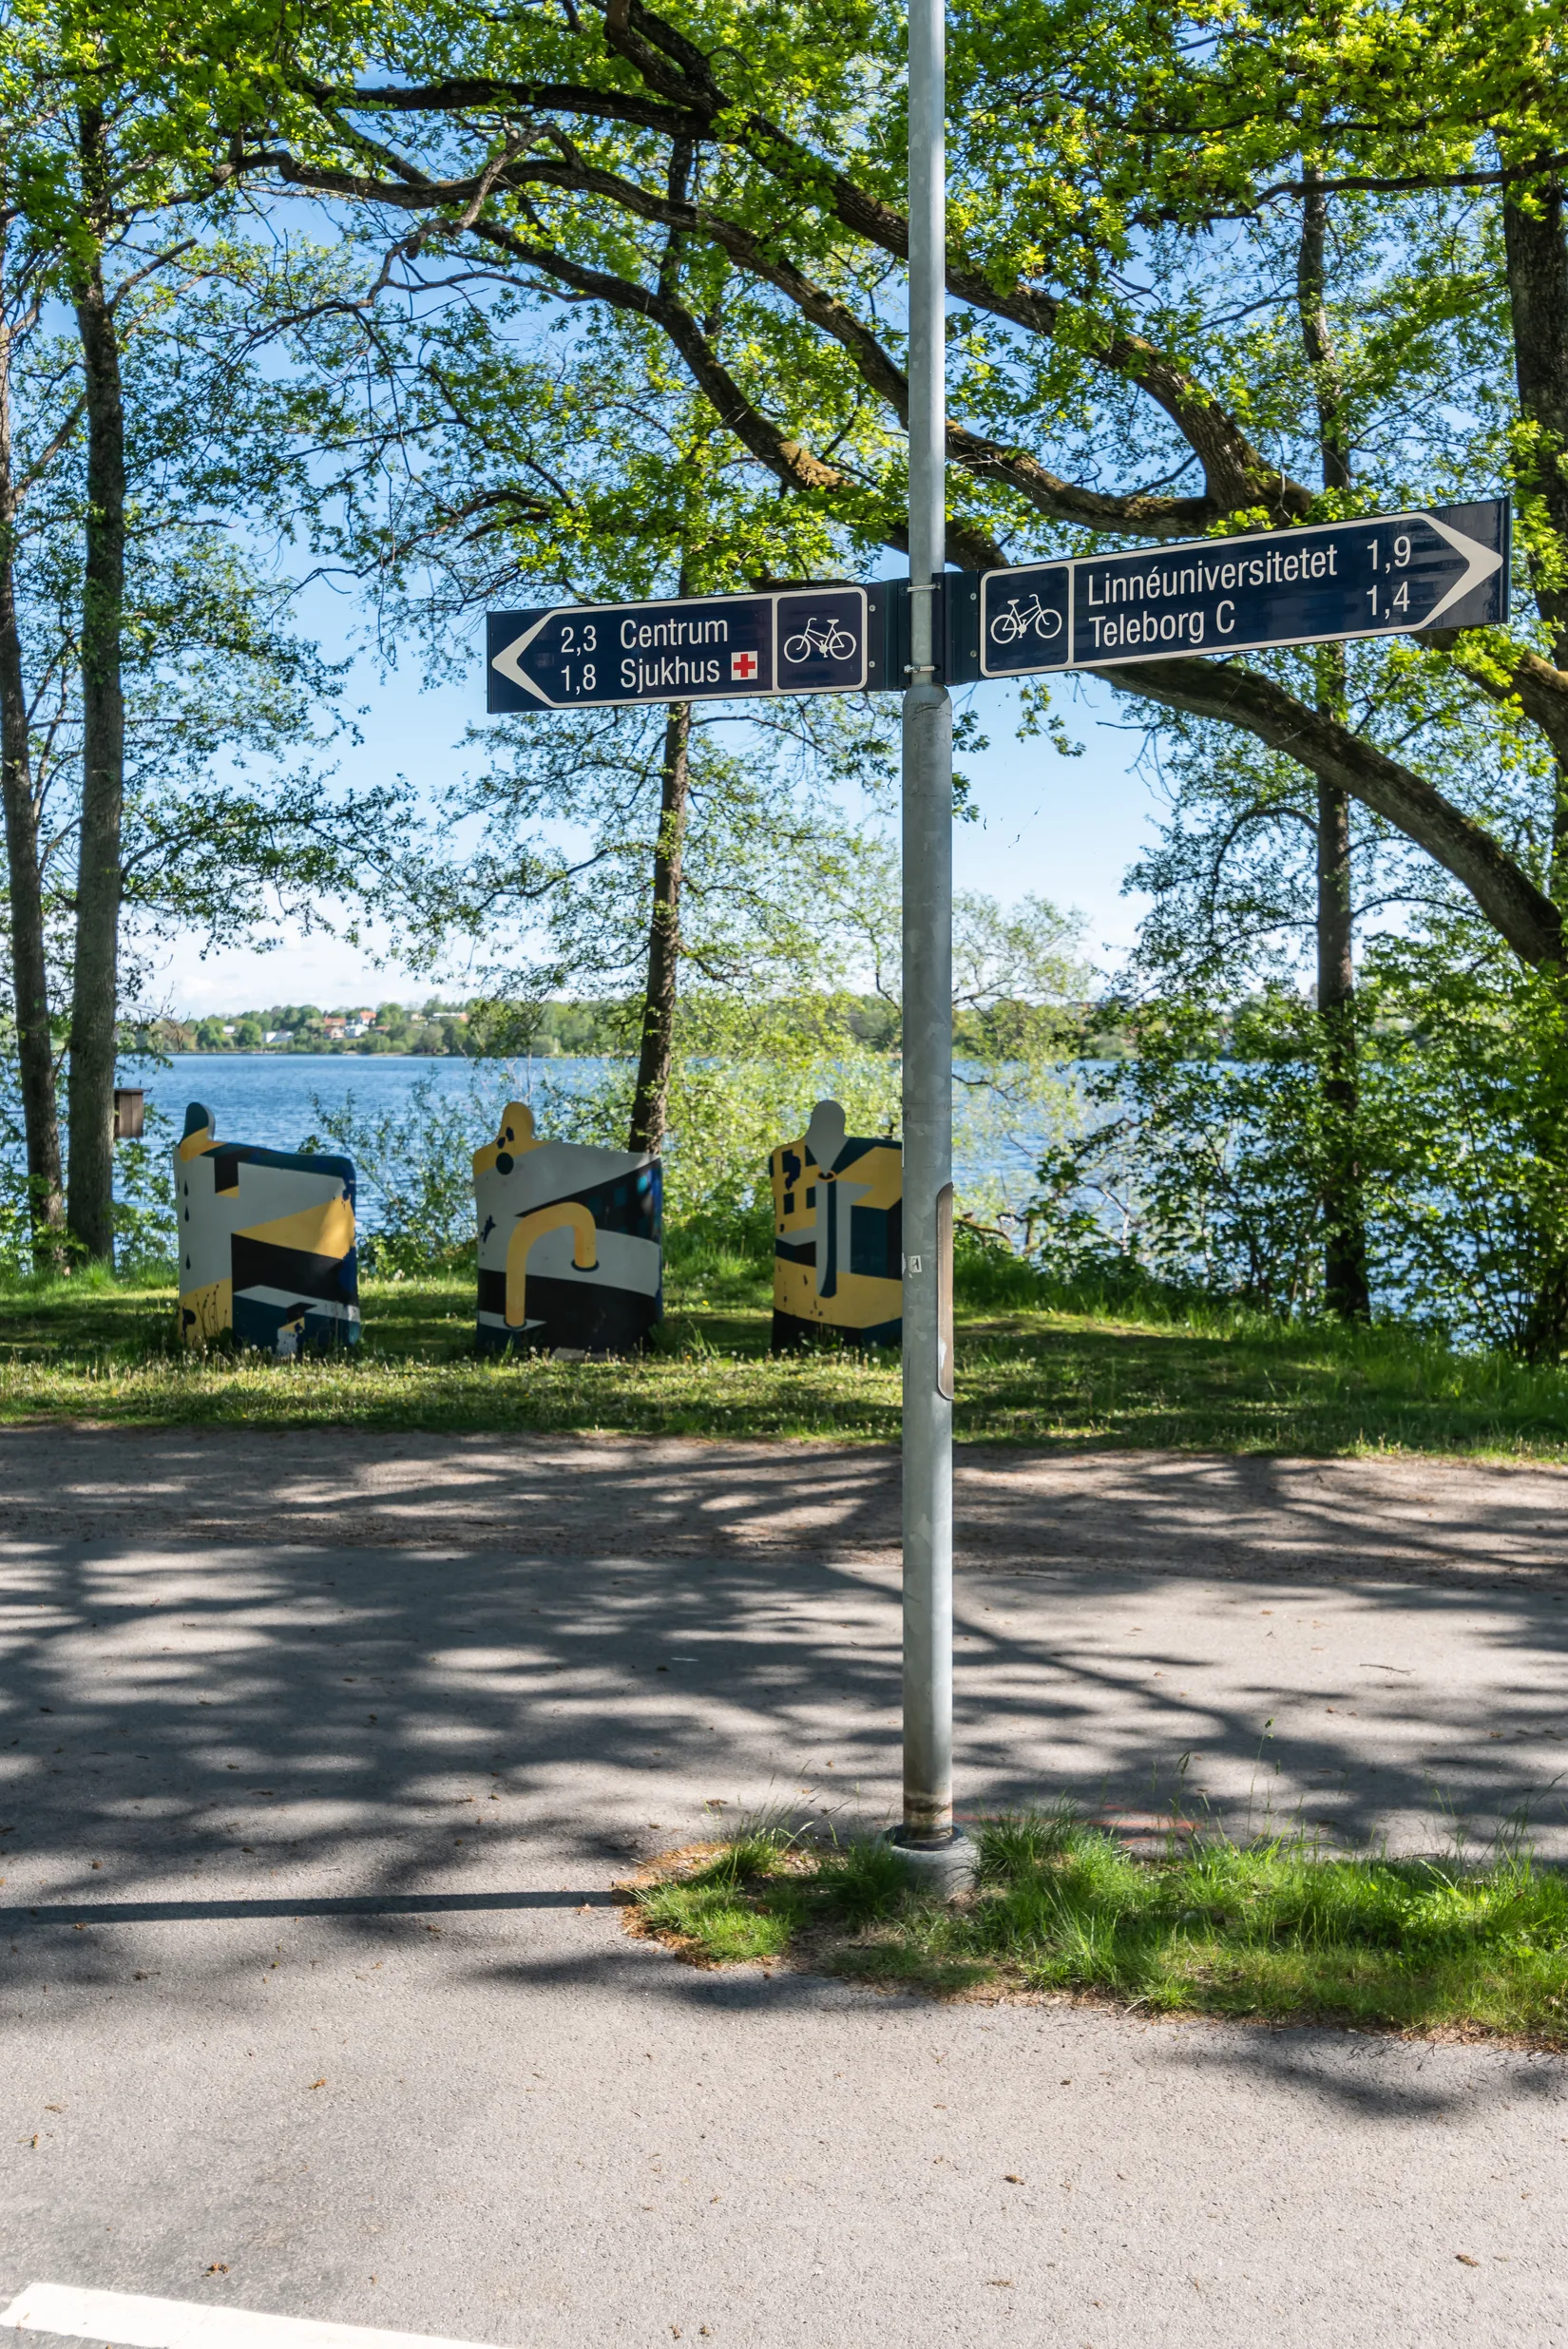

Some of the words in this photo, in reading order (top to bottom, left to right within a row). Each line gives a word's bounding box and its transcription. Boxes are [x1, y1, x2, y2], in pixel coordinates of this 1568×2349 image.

[1088, 544, 1338, 606] Linnéuniversitetet
[1367, 535, 1411, 574] 1,9
[561, 624, 597, 657] 2,3
[620, 618, 728, 649] Centrum
[1088, 611, 1205, 648] Teleborg
[1215, 600, 1235, 634] C
[1366, 581, 1410, 620] 1,4
[561, 664, 597, 696] 1,8
[620, 657, 720, 694] Sjukhus
